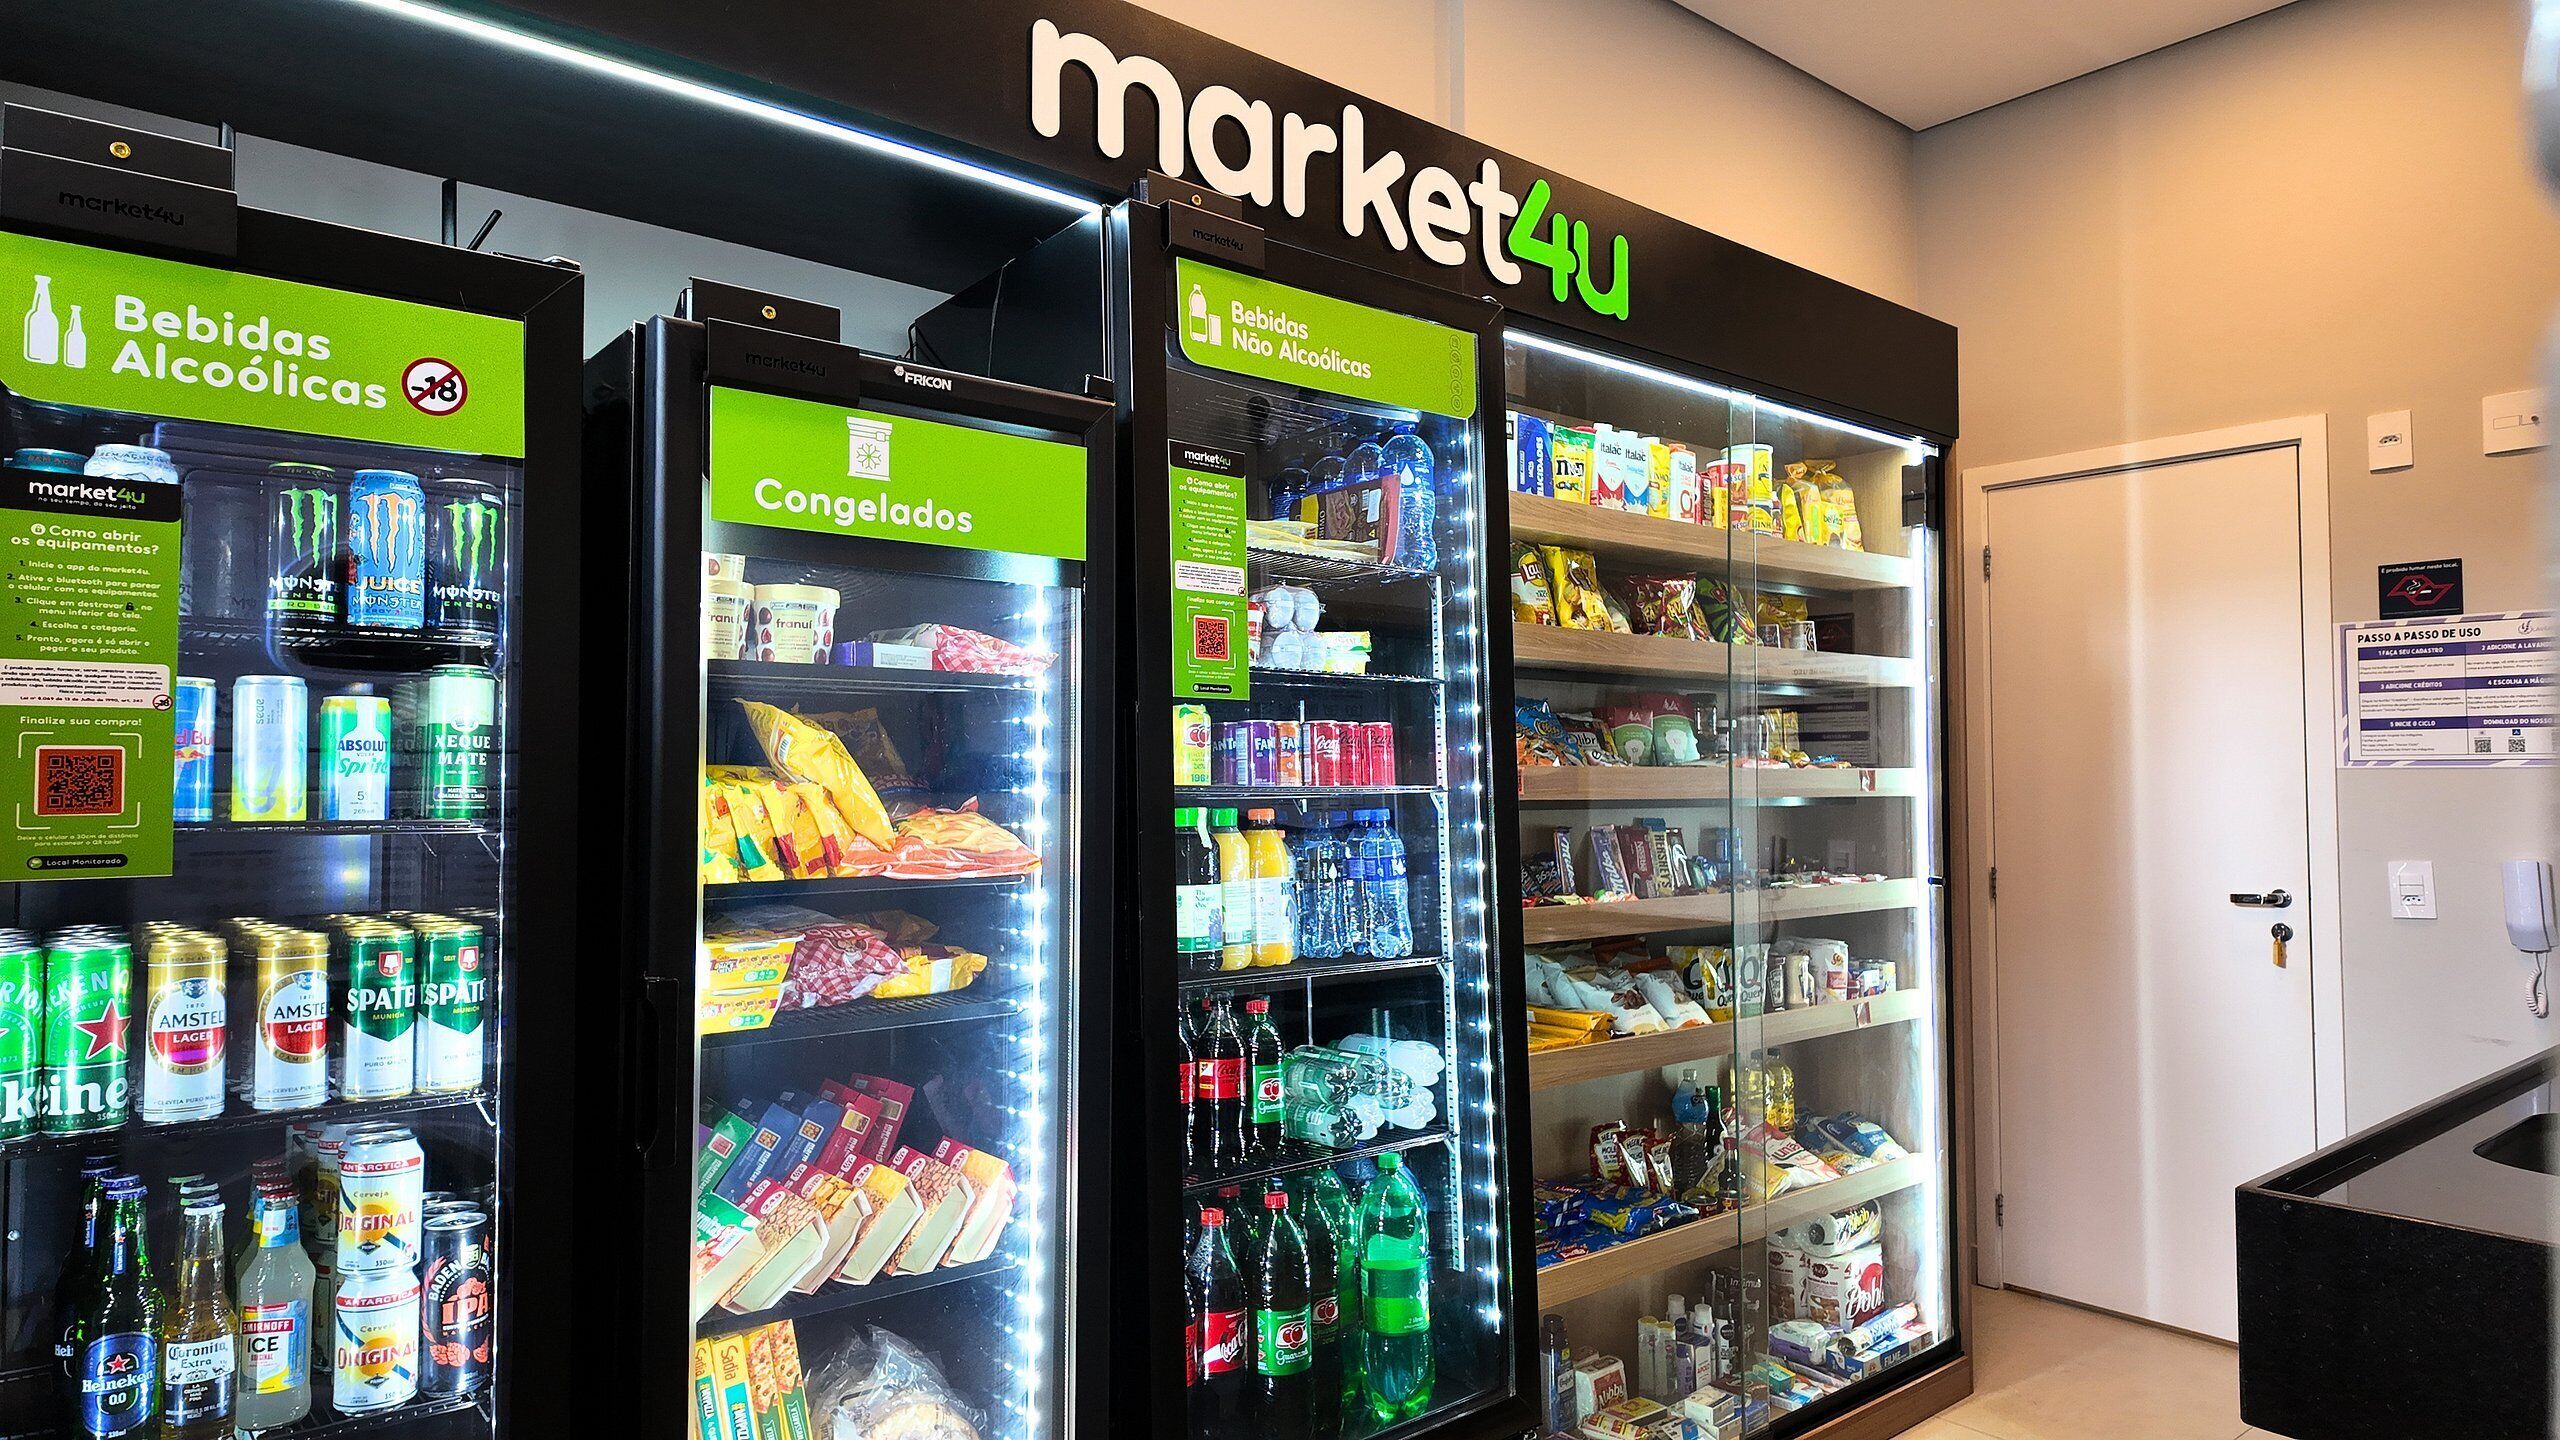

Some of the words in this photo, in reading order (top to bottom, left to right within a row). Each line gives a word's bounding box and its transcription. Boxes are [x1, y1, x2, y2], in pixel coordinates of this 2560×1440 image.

[1031, 18, 1630, 321] market4u
[58, 191, 185, 227] market4u
[1192, 228, 1244, 251] market4u
[115, 294, 331, 361] Bebidas
[1231, 300, 1309, 340] Bebidas
[1232, 327, 1273, 357] Não
[1278, 339, 1371, 379] Alcoólicas
[745, 351, 826, 378] market4u
[111, 339, 387, 409] Alcoólicas
[904, 372, 952, 391] FRICON
[1184, 450, 1231, 466] market4u
[29, 482, 146, 504] market4u
[754, 477, 973, 533] Congelados
[49, 525, 97, 539] Como
[102, 529, 142, 542] abrir
[10, 535, 30, 546] os
[36, 537, 160, 555] equipamentos?
[28, 560, 54, 569] Inicie
[66, 563, 85, 572] app
[17, 583, 51, 591] celular
[18, 574, 44, 582] Ative
[56, 576, 103, 586] bluetooth
[359, 576, 421, 595] JUICE
[26, 597, 57, 607] Clique
[42, 621, 79, 630] Escolha
[776, 618, 812, 629] franuí
[118, 638, 142, 646] abrir
[2358, 633, 2391, 643] PASSO
[2394, 632, 2401, 641] A
[2404, 630, 2439, 640] PASSO
[2442, 629, 2456, 638] DE
[2459, 627, 2481, 637] USO
[39, 645, 69, 653] pegar
[20, 716, 65, 726] Finalize
[95, 717, 142, 727] compra!
[337, 740, 388, 752] ABSOLUT
[435, 735, 491, 749] XEQUE
[339, 758, 388, 777] Sprite
[438, 753, 487, 766] MATE
[47, 859, 70, 867] Local
[1654, 834, 1671, 889] HERSHEY'S
[160, 1010, 224, 1028] AMSTEL
[287, 1020, 323, 1034] LAGER
[172, 1031, 214, 1043] LAGER
[428, 1260, 461, 1301] BADEN
[442, 1294, 488, 1323] IPA
[243, 1320, 290, 1334] SMIRNOFF
[168, 1341, 228, 1360] Coronita
[247, 1336, 279, 1354] ICE
[182, 1359, 211, 1369] Extra
[721, 1345, 738, 1380] Sadia
[82, 1370, 153, 1393] Heineken
